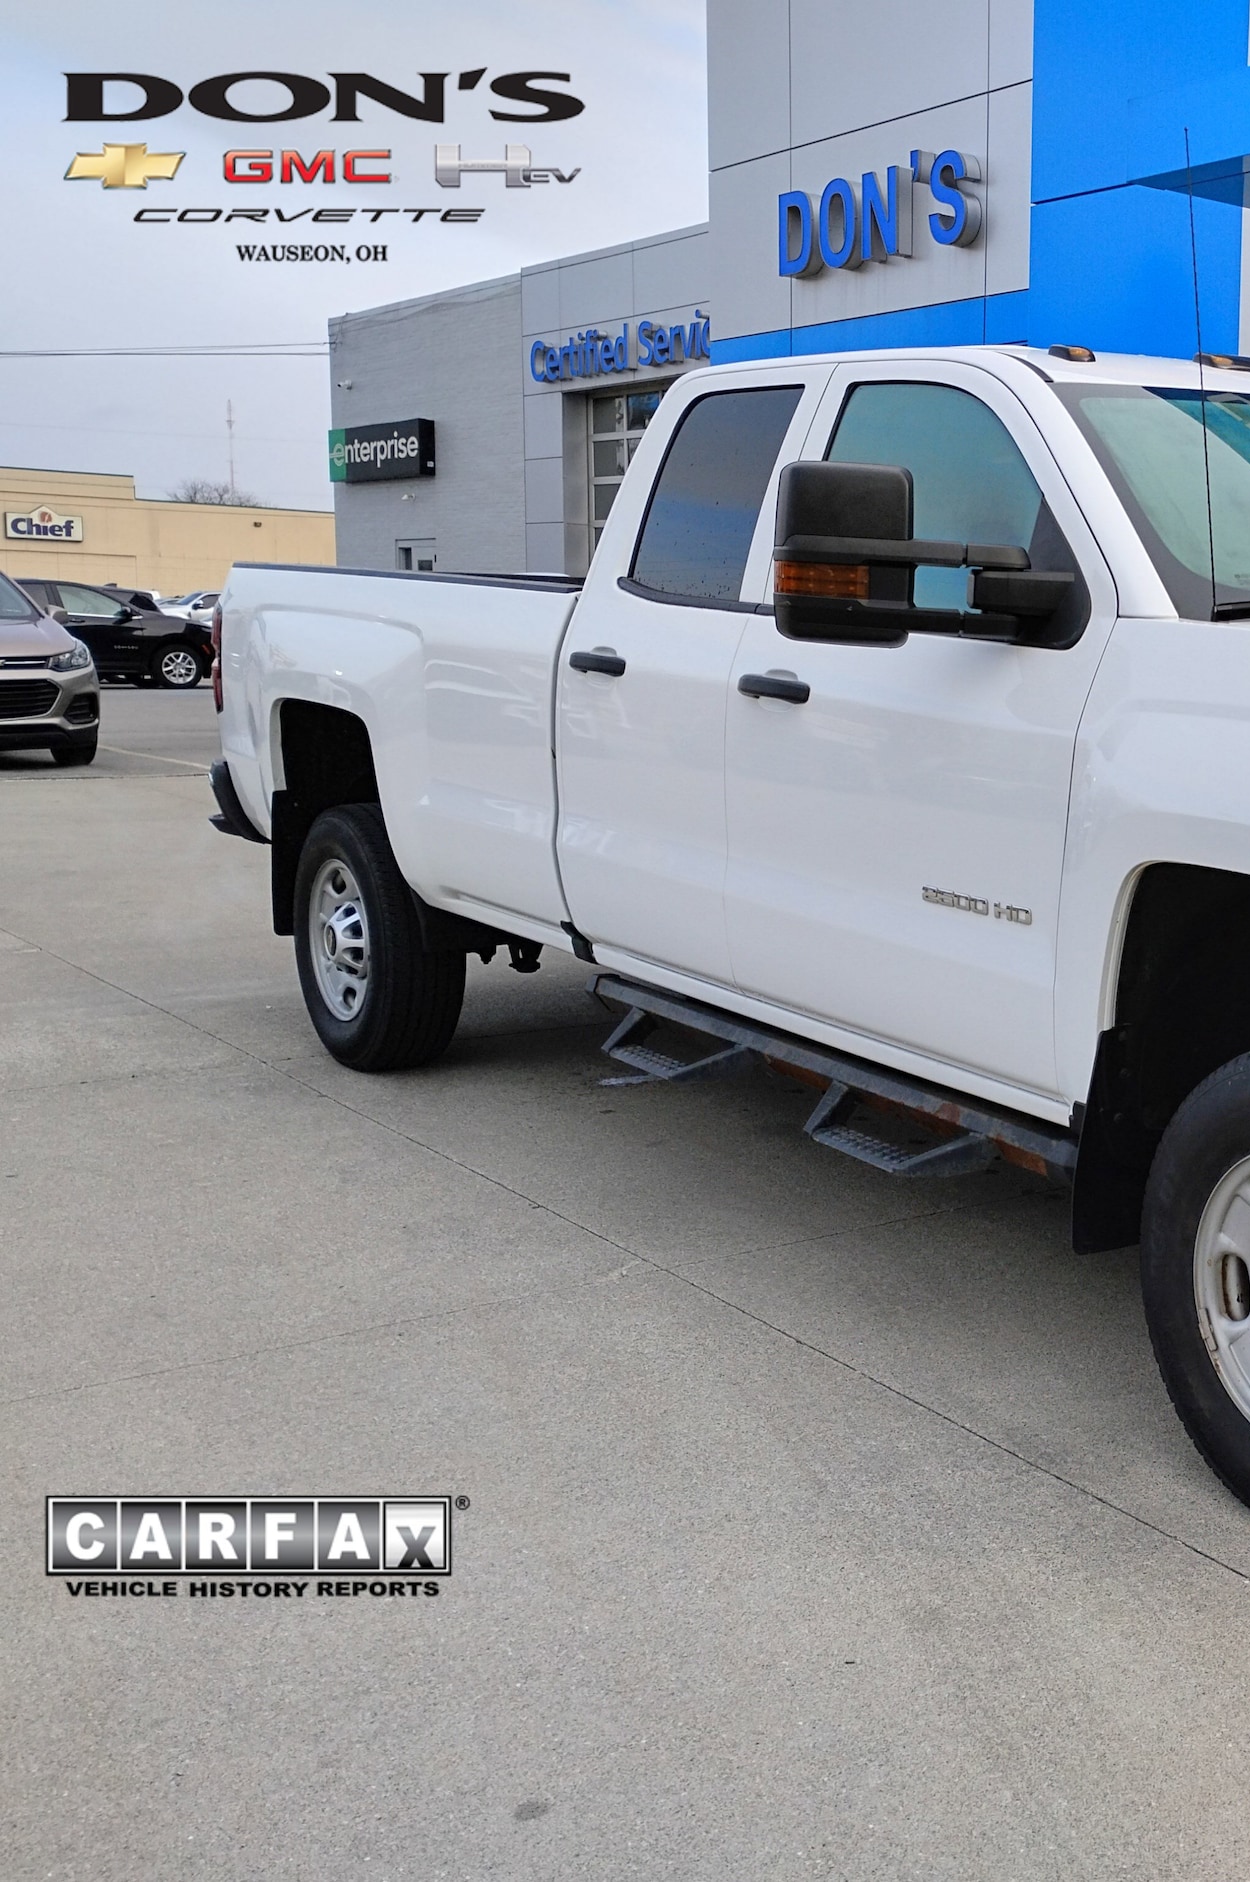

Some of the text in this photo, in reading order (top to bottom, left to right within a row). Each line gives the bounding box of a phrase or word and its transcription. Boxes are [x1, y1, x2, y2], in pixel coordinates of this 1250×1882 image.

[778, 149, 982, 279] DON'S
[530, 328, 629, 382] Certified
[329, 431, 419, 468] enterprise
[11, 518, 74, 537] Chief
[922, 885, 1032, 926] 2500 HD
